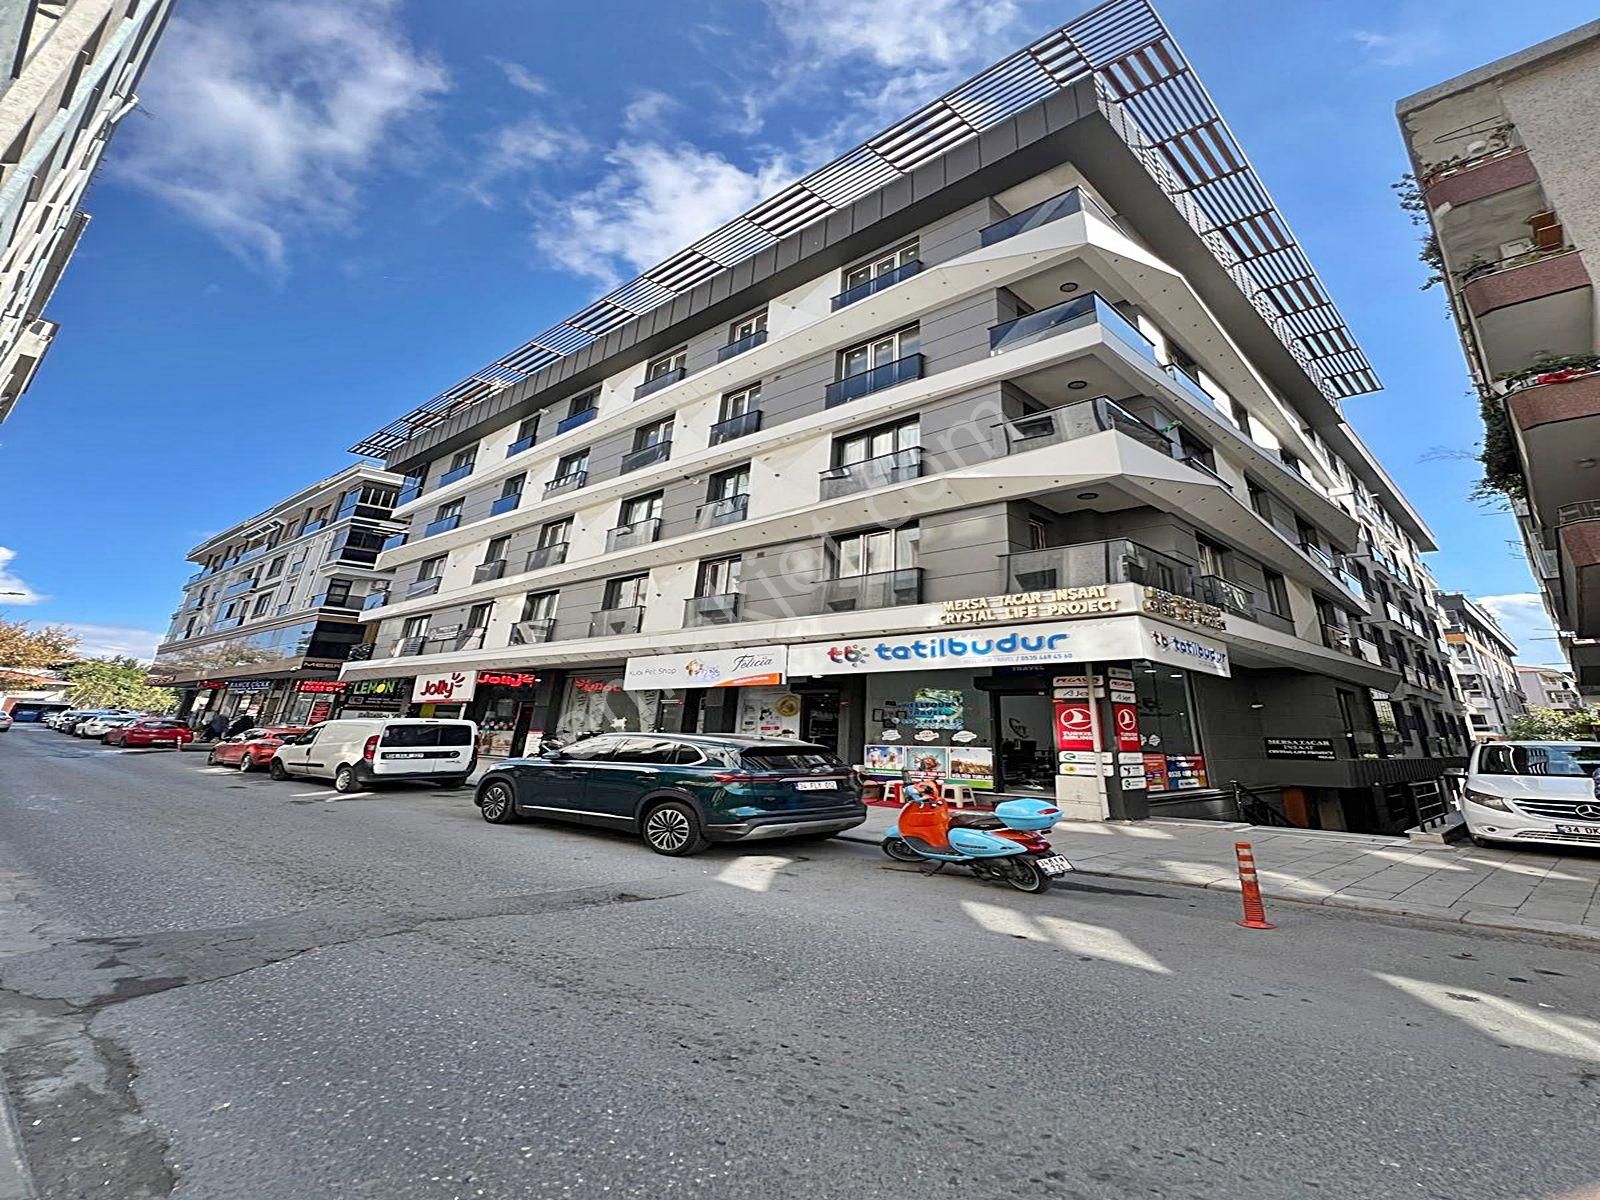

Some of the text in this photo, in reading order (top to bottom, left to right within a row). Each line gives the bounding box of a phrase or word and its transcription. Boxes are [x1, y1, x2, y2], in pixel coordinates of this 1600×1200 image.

[937, 599, 1120, 625] CRYSTAL LIFE PROJECT
[943, 598, 989, 613] MERSA
[999, 591, 1042, 607] TACAR
[874, 632, 1070, 661] tatilbudur
[1173, 636, 1226, 663] tatilbudur
[658, 667, 677, 675] Shop
[732, 653, 773, 672] Felicia
[353, 681, 396, 695] LEMON
[420, 680, 453, 698] Jolly
